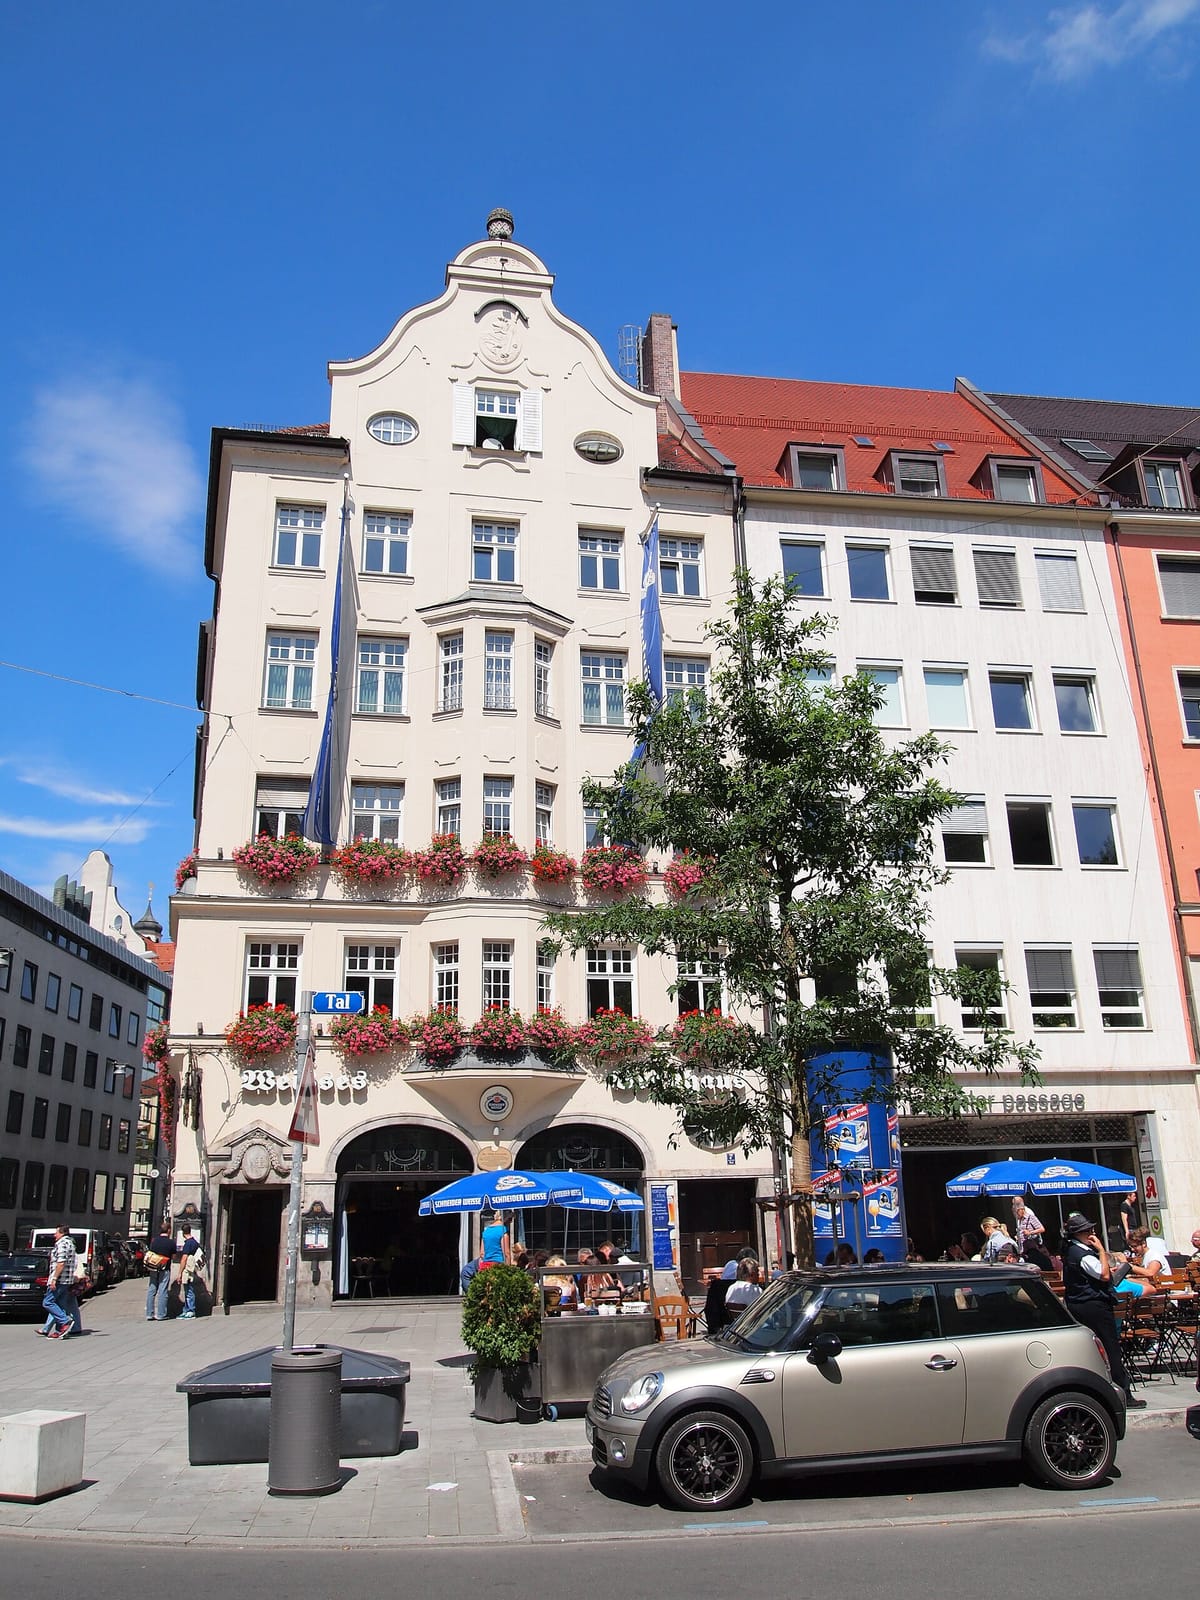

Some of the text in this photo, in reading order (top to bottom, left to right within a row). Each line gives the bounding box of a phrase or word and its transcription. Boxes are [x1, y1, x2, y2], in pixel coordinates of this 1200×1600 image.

[325, 994, 350, 1009] Tal
[241, 1069, 367, 1091] Weises
[1002, 1093, 1085, 1112] passage
[1033, 1181, 1090, 1190] SCHNEIDER WEISSE
[491, 1192, 548, 1204] SCHNEIDER WEISSE
